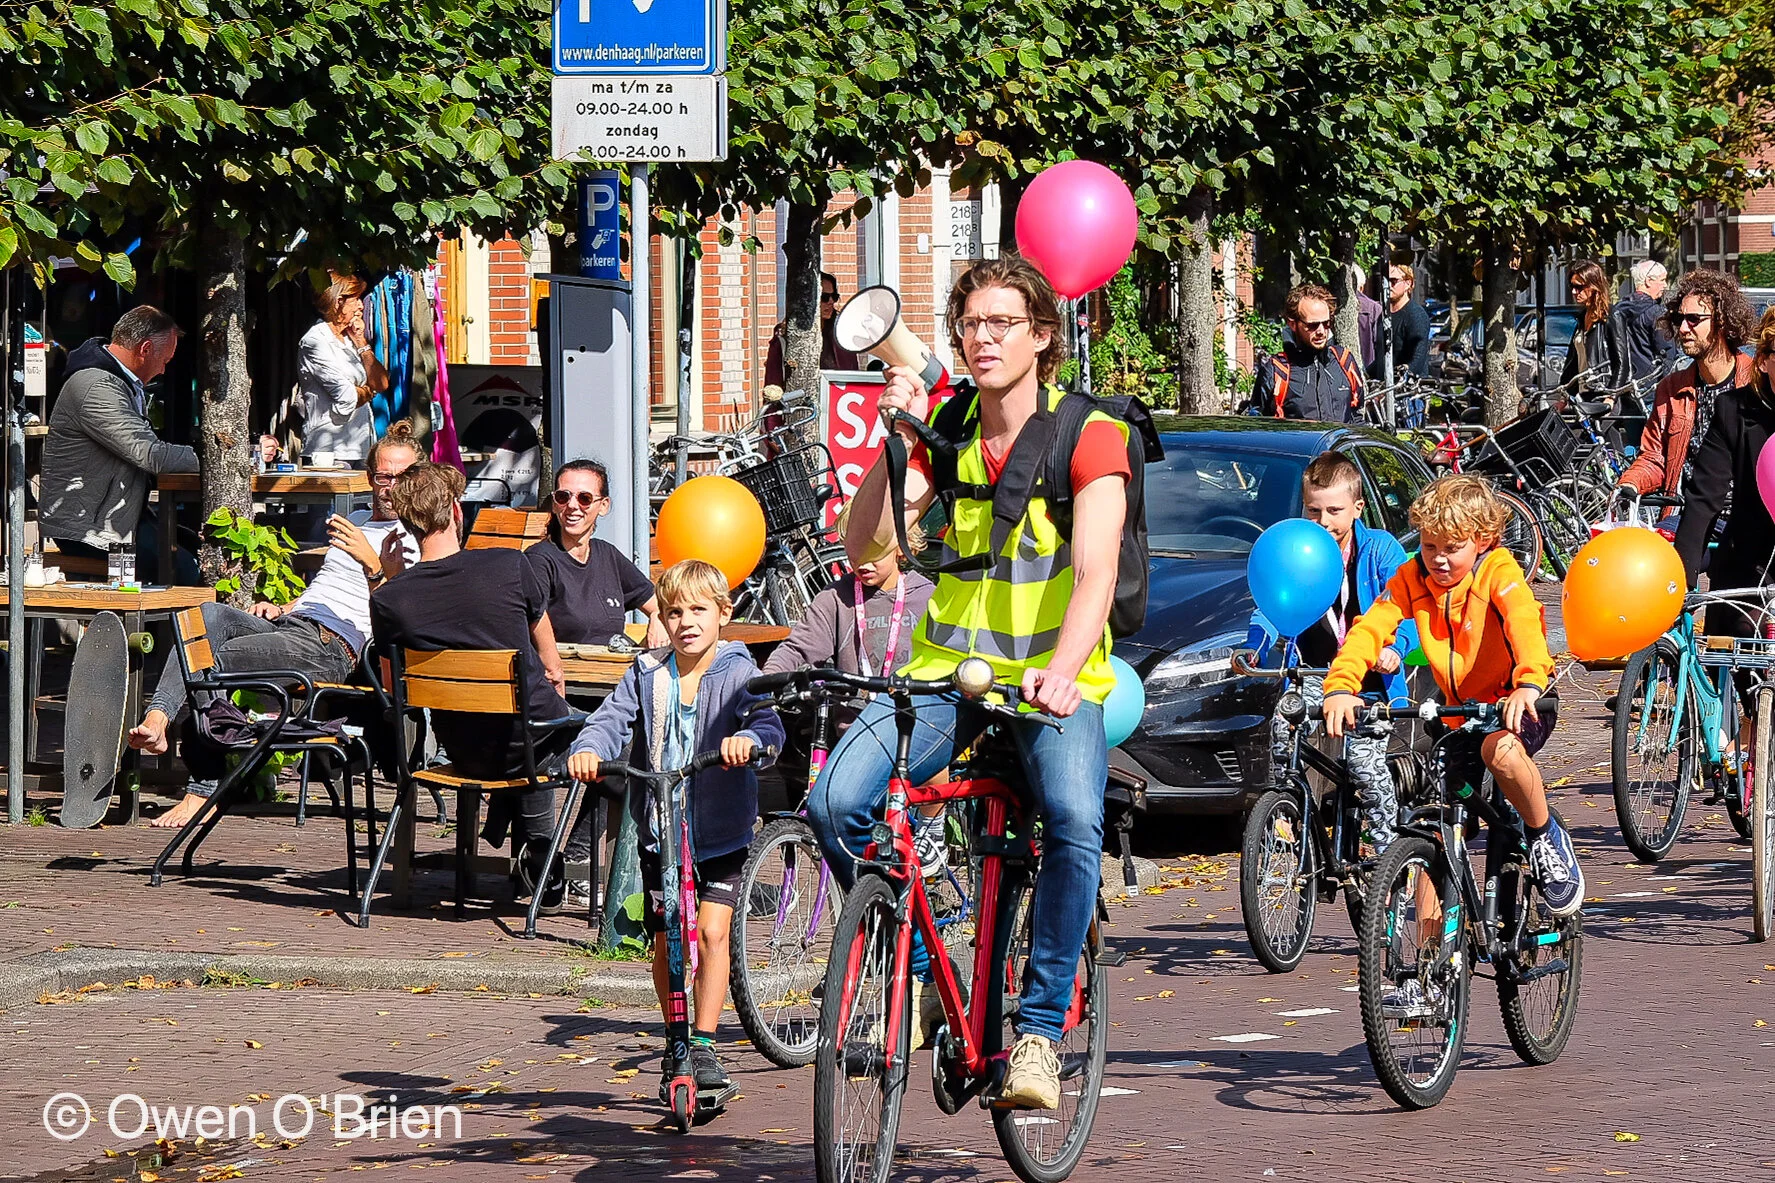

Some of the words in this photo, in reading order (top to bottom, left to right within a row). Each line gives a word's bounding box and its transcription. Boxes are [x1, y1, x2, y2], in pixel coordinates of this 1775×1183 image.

[561, 43, 704, 64] www.denhaag.nl/parkeren
[591, 83, 614, 94] ma
[620, 80, 649, 94] t/m
[656, 83, 673, 94] za
[576, 102, 673, 115] 09.00-24.00
[679, 102, 688, 115] h
[606, 124, 658, 140] zondag
[677, 145, 686, 158] h
[587, 184, 615, 227] P
[954, 242, 976, 255] 218
[472, 394, 543, 407] MSR
